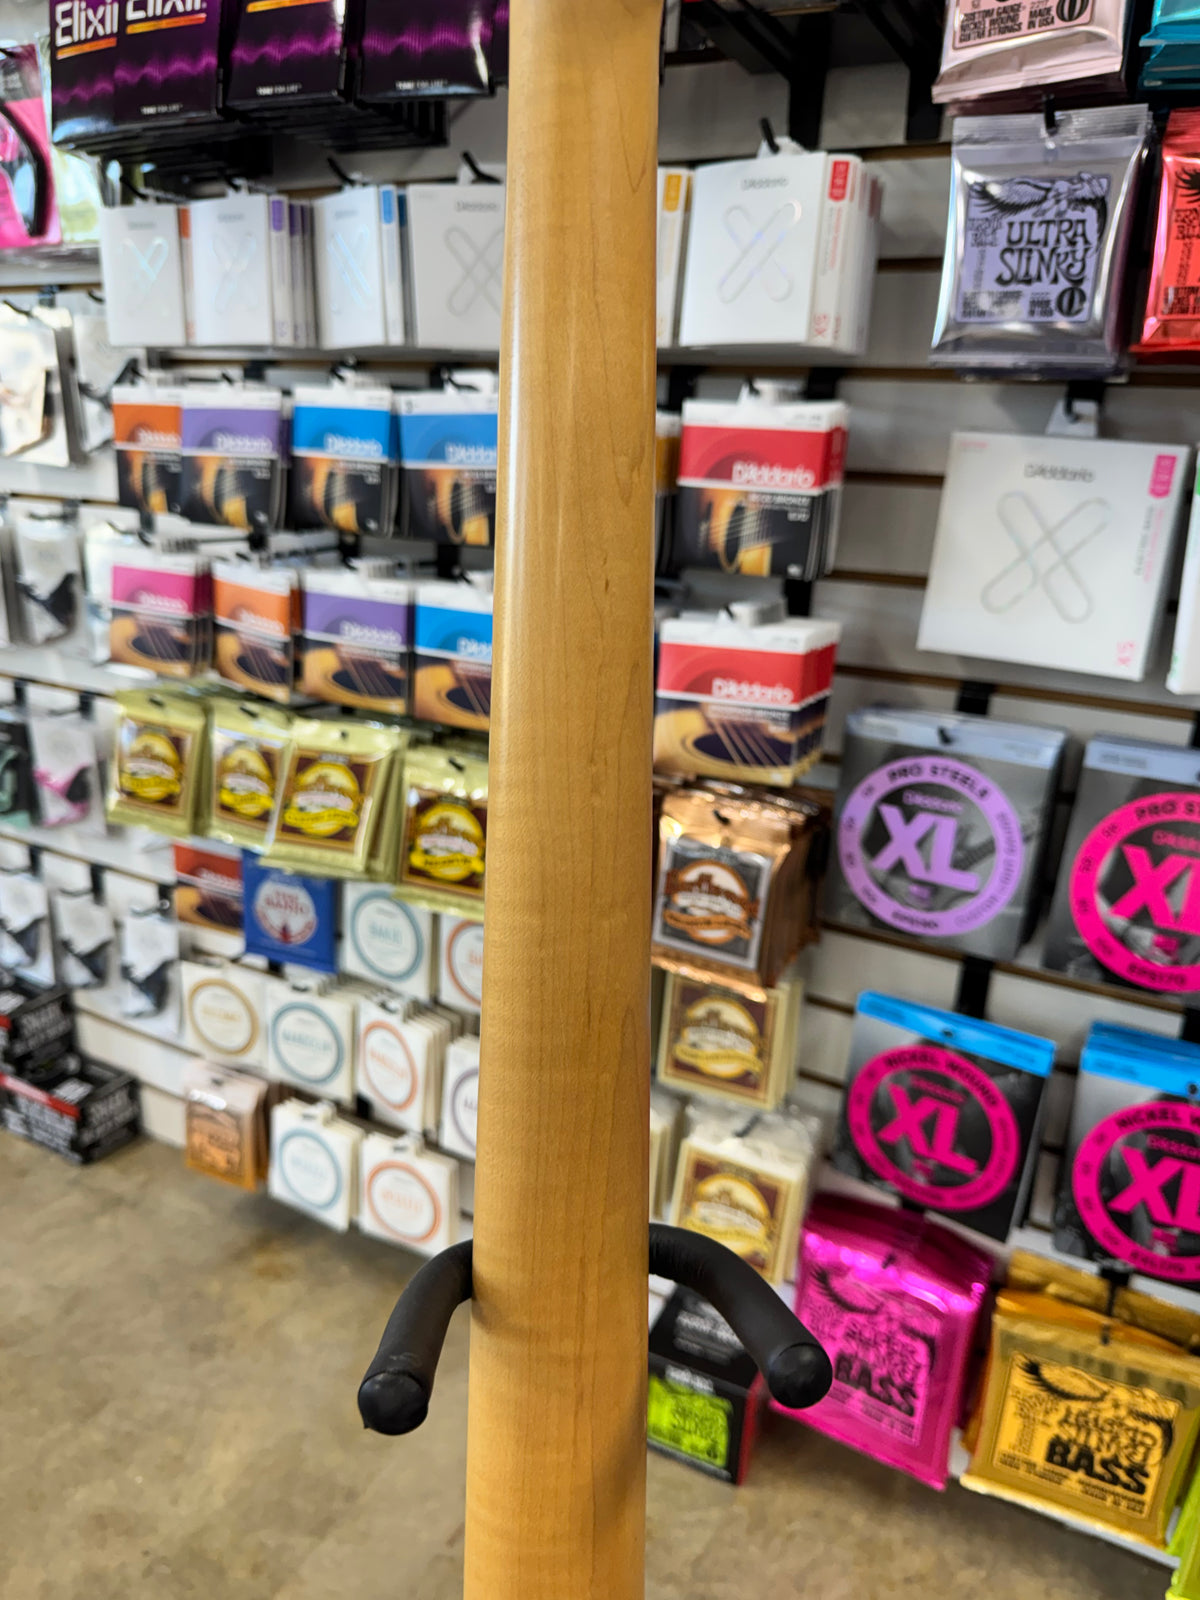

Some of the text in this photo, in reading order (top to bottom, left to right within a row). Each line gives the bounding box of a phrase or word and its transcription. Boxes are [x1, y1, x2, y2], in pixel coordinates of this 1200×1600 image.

[1027, 15, 1054, 29] IN USA
[1029, 6, 1053, 18] MADE
[1007, 219, 1092, 247] ULTRA
[995, 246, 1092, 286] SLINKY
[731, 460, 816, 489] D'Addario
[888, 763, 990, 800] PRO STEELS
[1135, 802, 1178, 822] PRO
[871, 802, 981, 893] XL
[877, 1081, 979, 1176] XL
[834, 1351, 918, 1417] BASS
[1045, 1434, 1150, 1496] BASS
